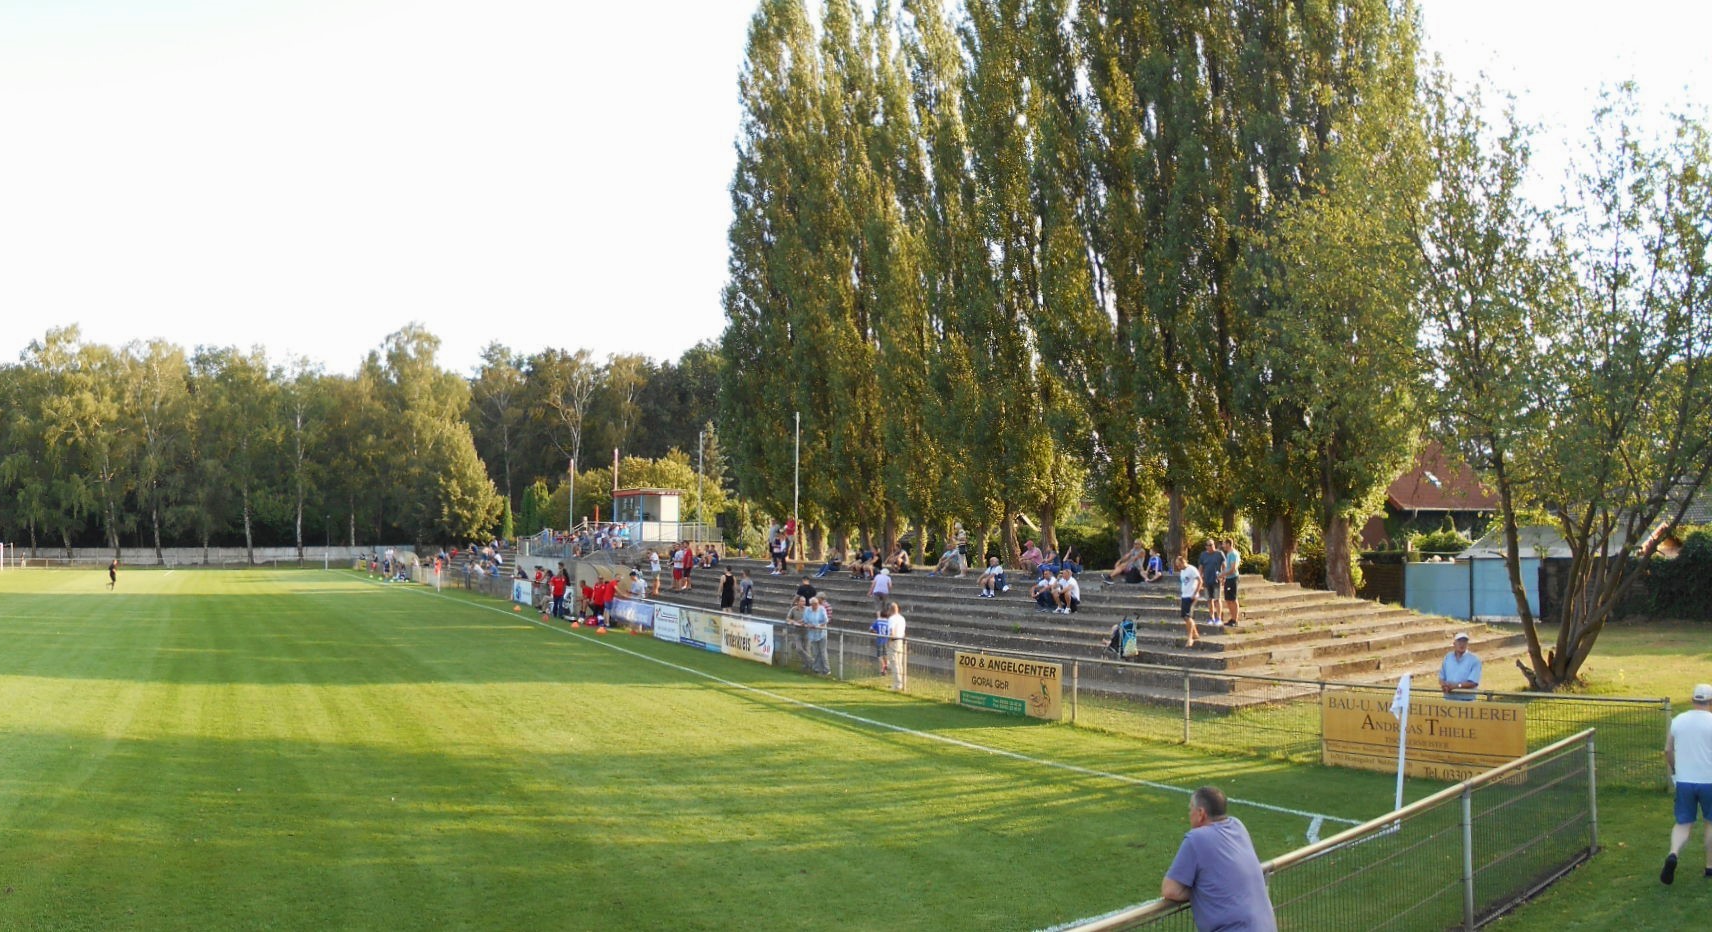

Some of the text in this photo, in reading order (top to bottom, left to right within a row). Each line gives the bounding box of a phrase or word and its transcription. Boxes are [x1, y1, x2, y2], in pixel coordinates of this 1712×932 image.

[959, 655, 1057, 678] ZOO & ANGELCENTER
[1361, 713, 1423, 735] ANDRAS
